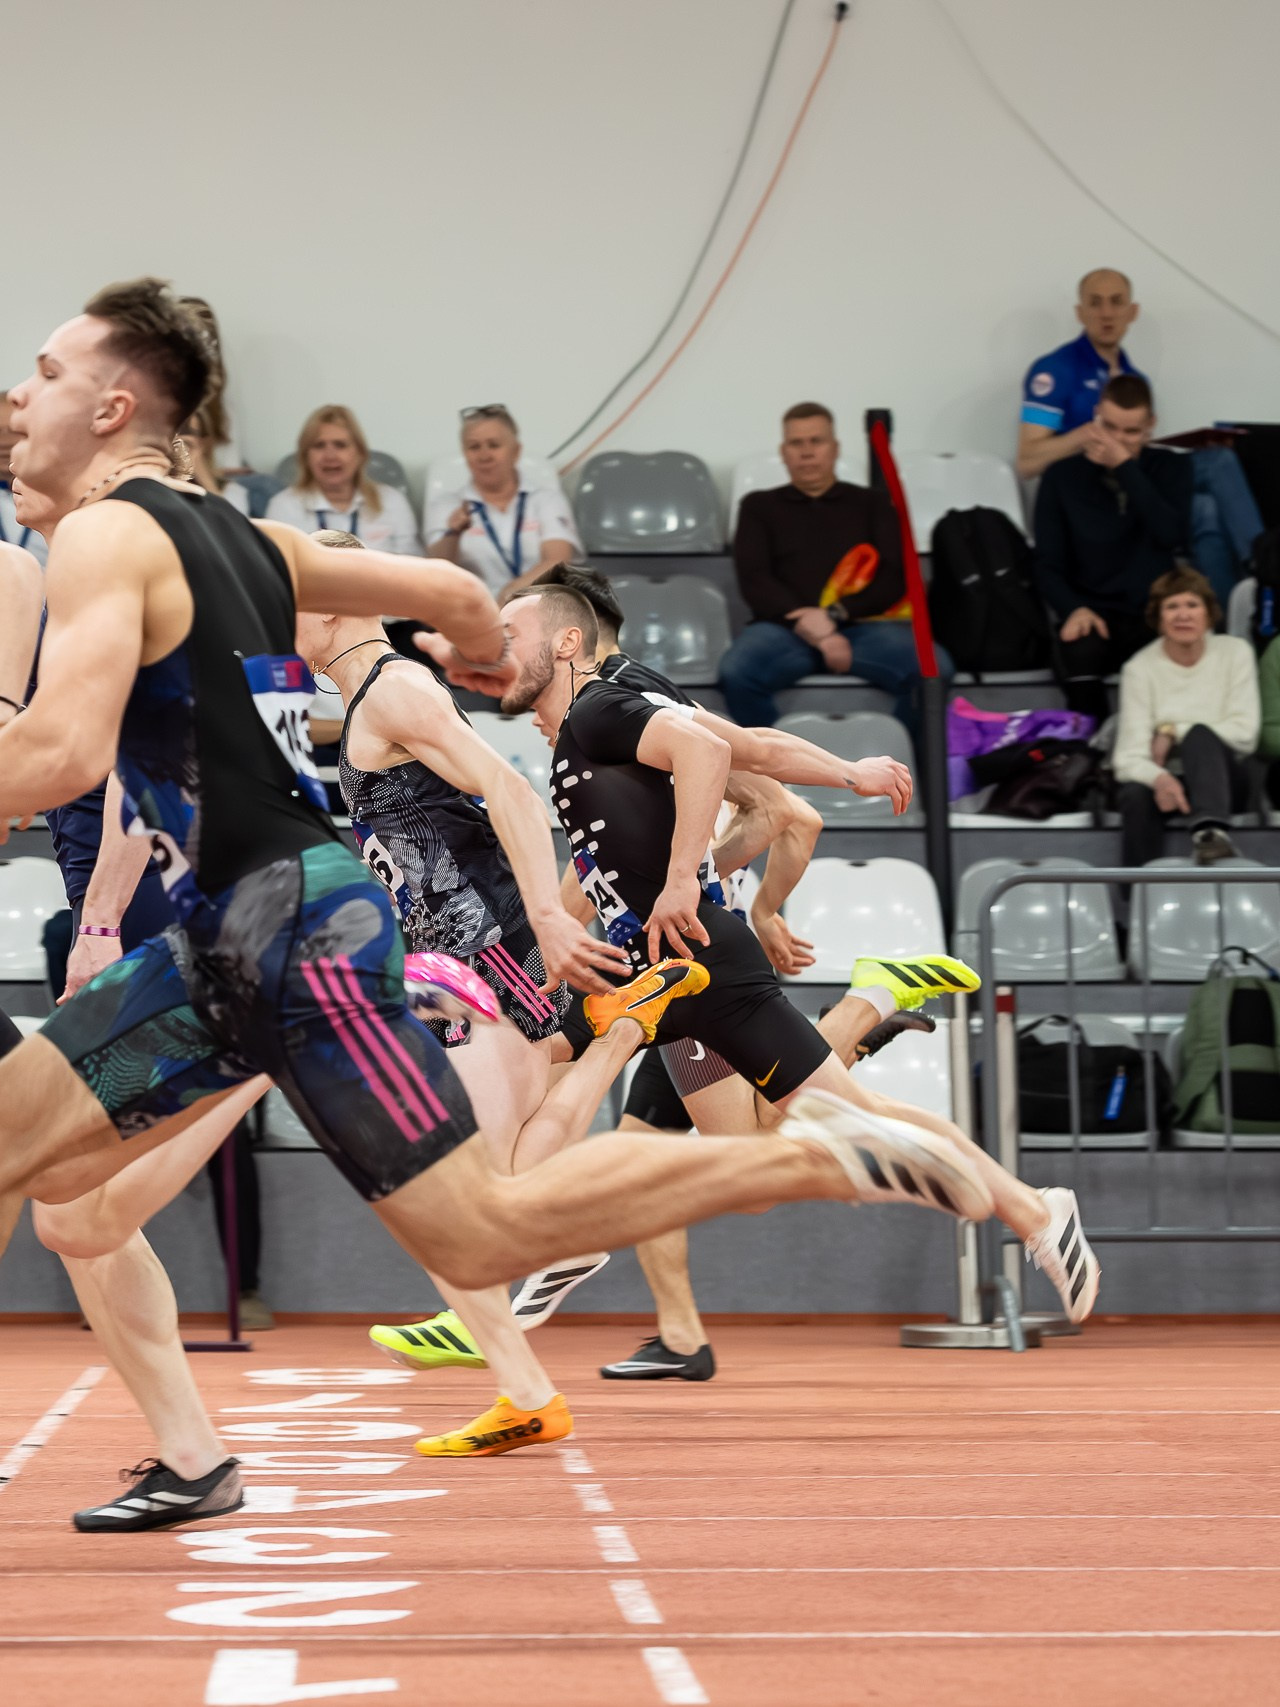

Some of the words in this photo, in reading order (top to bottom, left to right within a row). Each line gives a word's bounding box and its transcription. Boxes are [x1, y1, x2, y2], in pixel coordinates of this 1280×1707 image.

[242, 1367, 417, 1386] 8
[219, 1392, 403, 1413] 7
[217, 1421, 424, 1442] 6
[175, 1526, 394, 1565] 3
[165, 1580, 422, 1628] 2
[204, 1648, 400, 1707] 1
